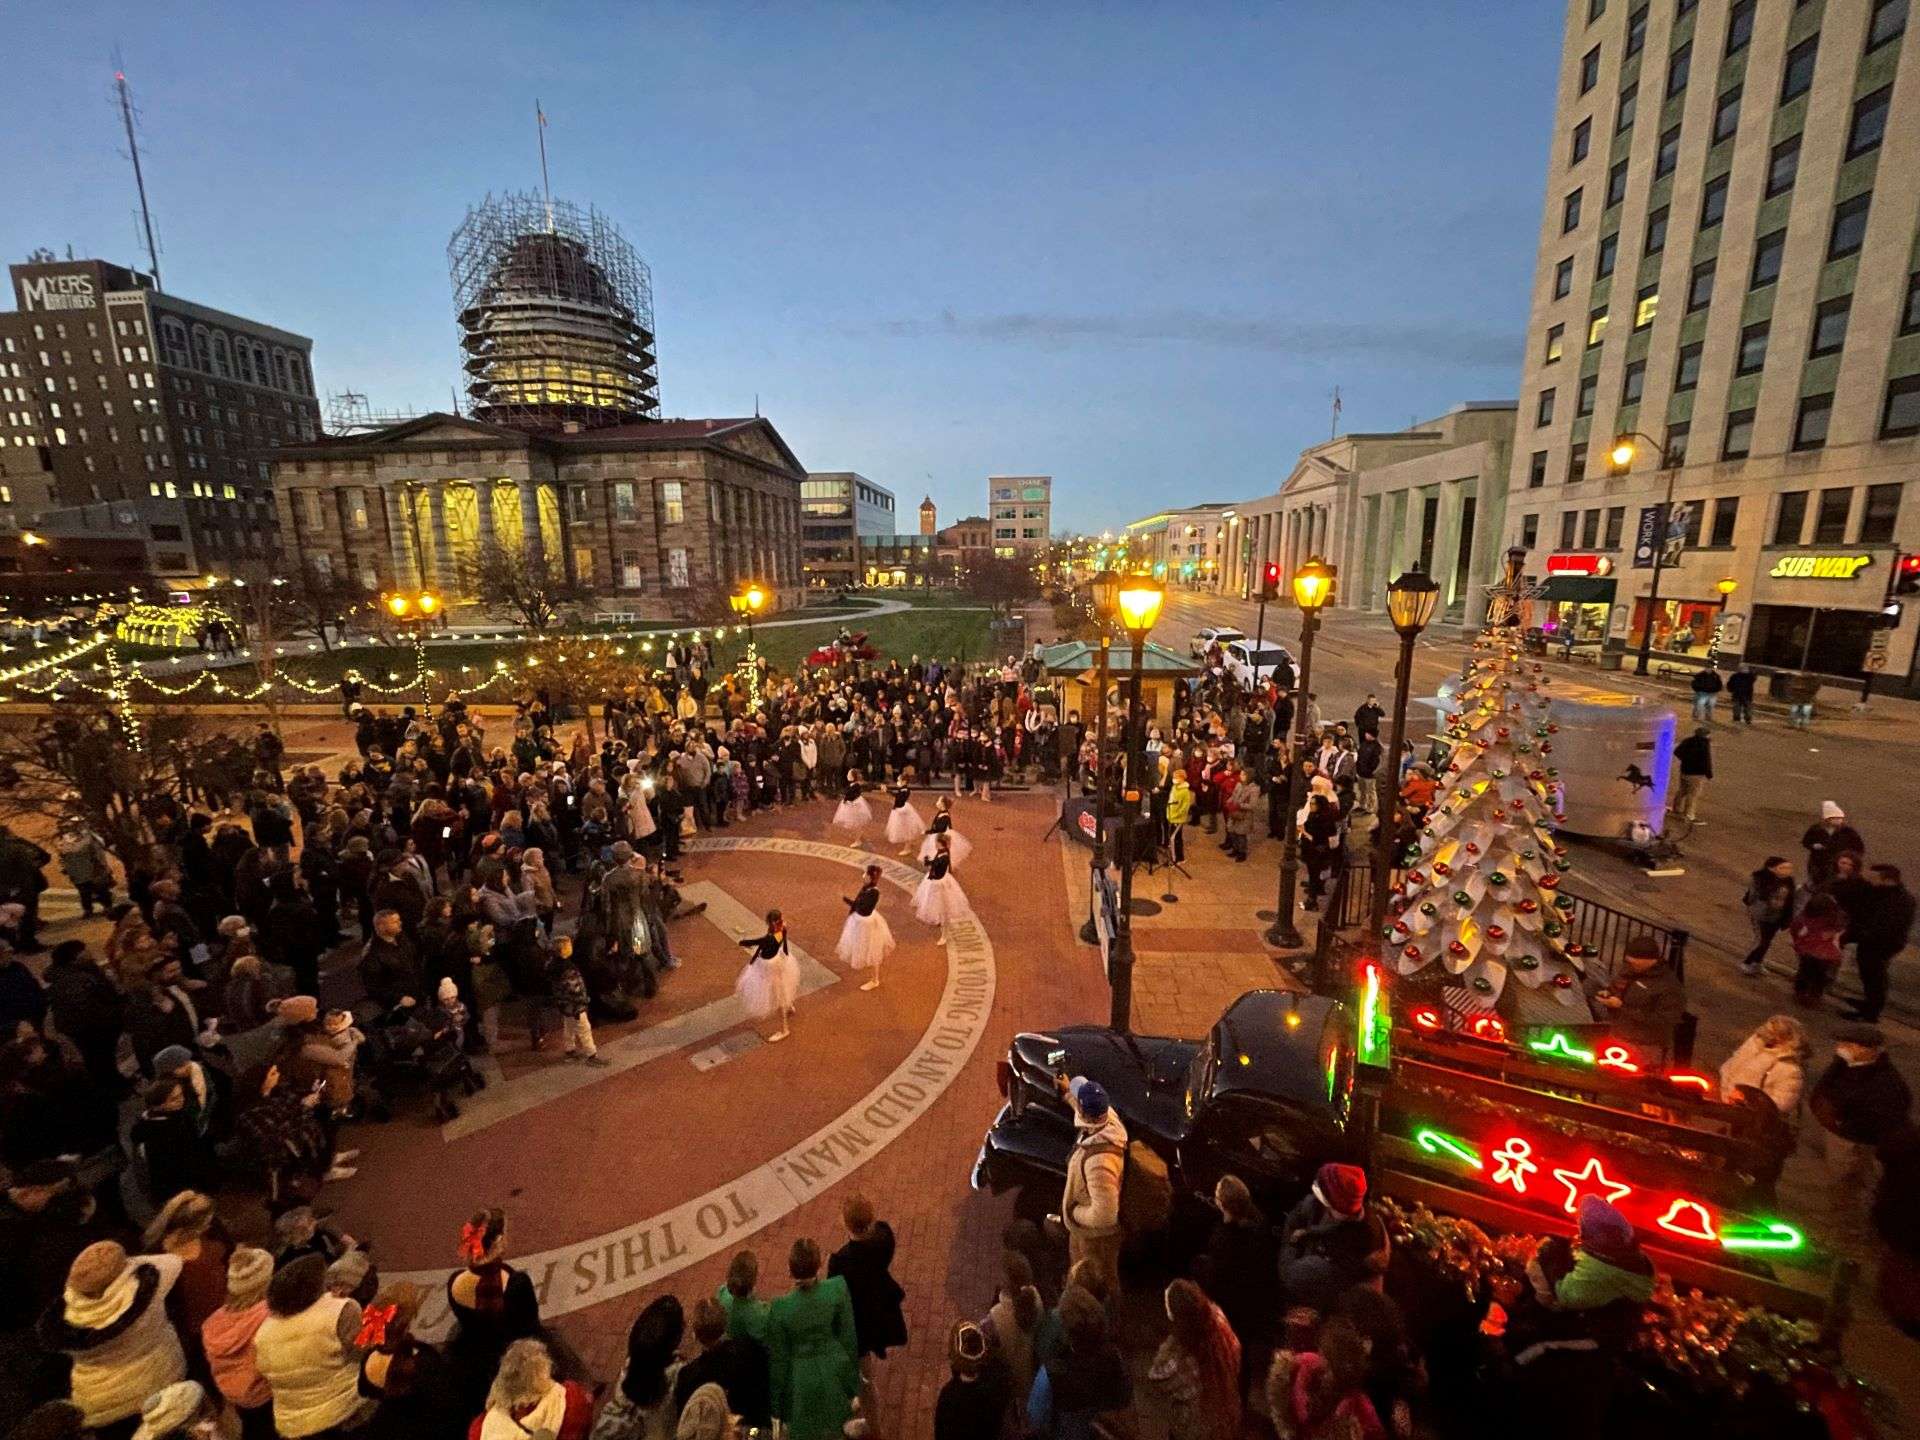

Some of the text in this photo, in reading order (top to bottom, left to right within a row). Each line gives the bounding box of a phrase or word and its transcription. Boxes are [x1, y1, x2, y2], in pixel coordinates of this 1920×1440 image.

[22, 274, 93, 311] MYERS
[1640, 511, 1657, 545] WORK
[1769, 556, 1870, 578] SUBWAY
[946, 969, 988, 1022] YOUNG
[932, 1026, 973, 1051] TO
[908, 1050, 953, 1084] AN
[863, 1082, 927, 1130] OLD
[695, 1191, 760, 1241] TO
[573, 1221, 689, 1297] THIS
